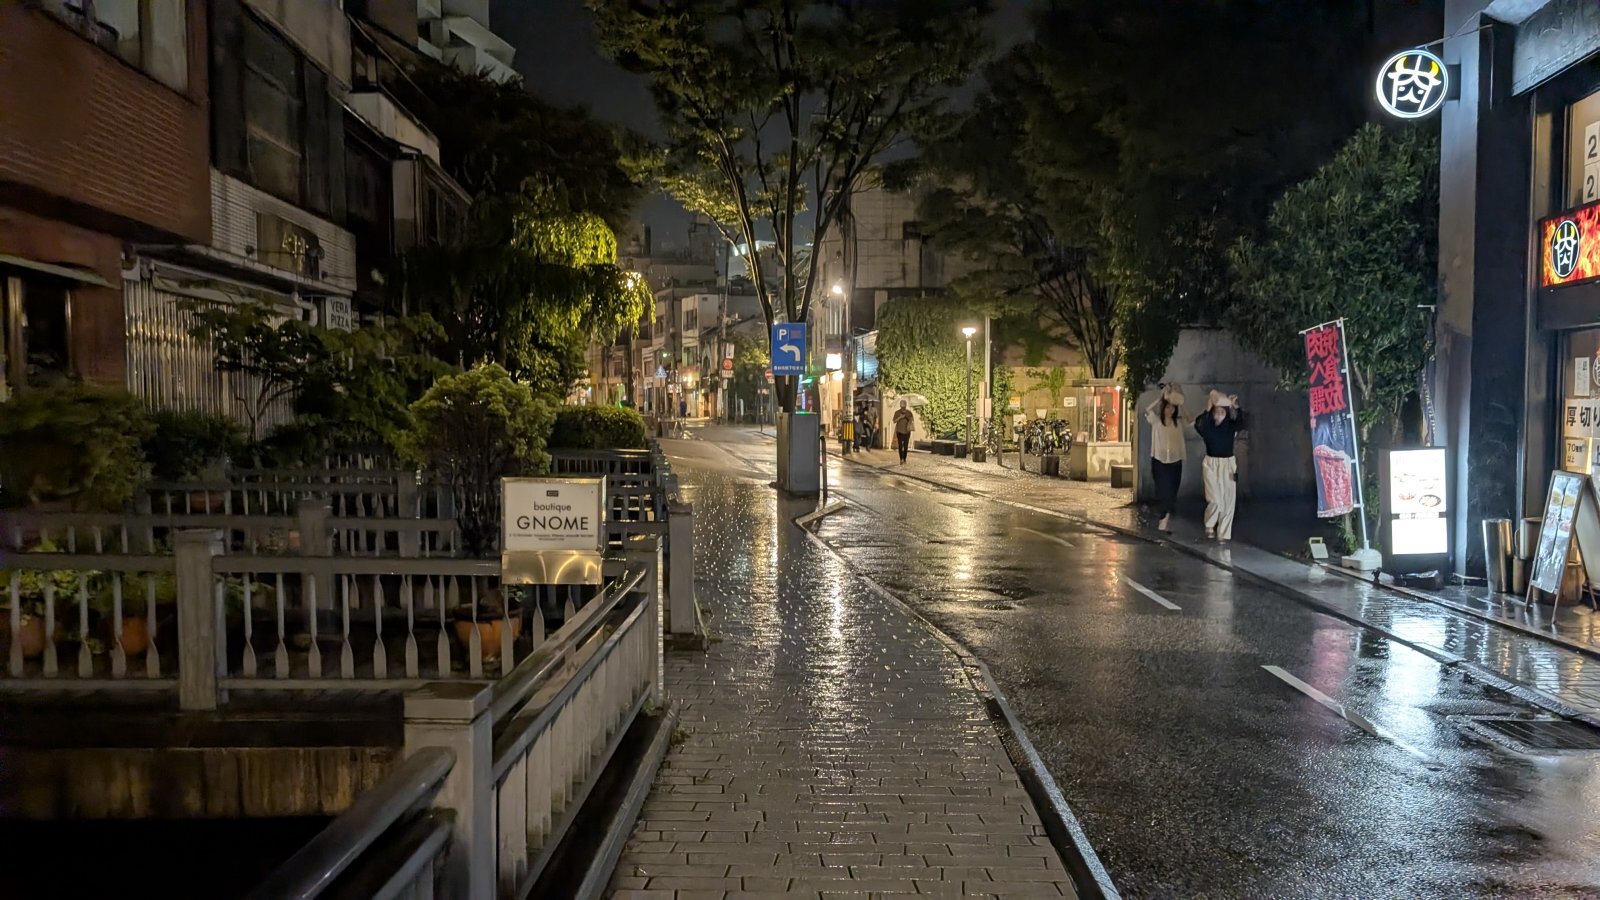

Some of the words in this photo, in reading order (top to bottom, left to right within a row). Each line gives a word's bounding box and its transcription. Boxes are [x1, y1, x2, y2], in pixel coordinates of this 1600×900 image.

[1588, 134, 1598, 159] 2
[1586, 174, 1595, 198] 2
[330, 313, 350, 329] PIZZA
[779, 329, 787, 340] P
[534, 501, 572, 512] boutique
[517, 516, 588, 530] GNOME
